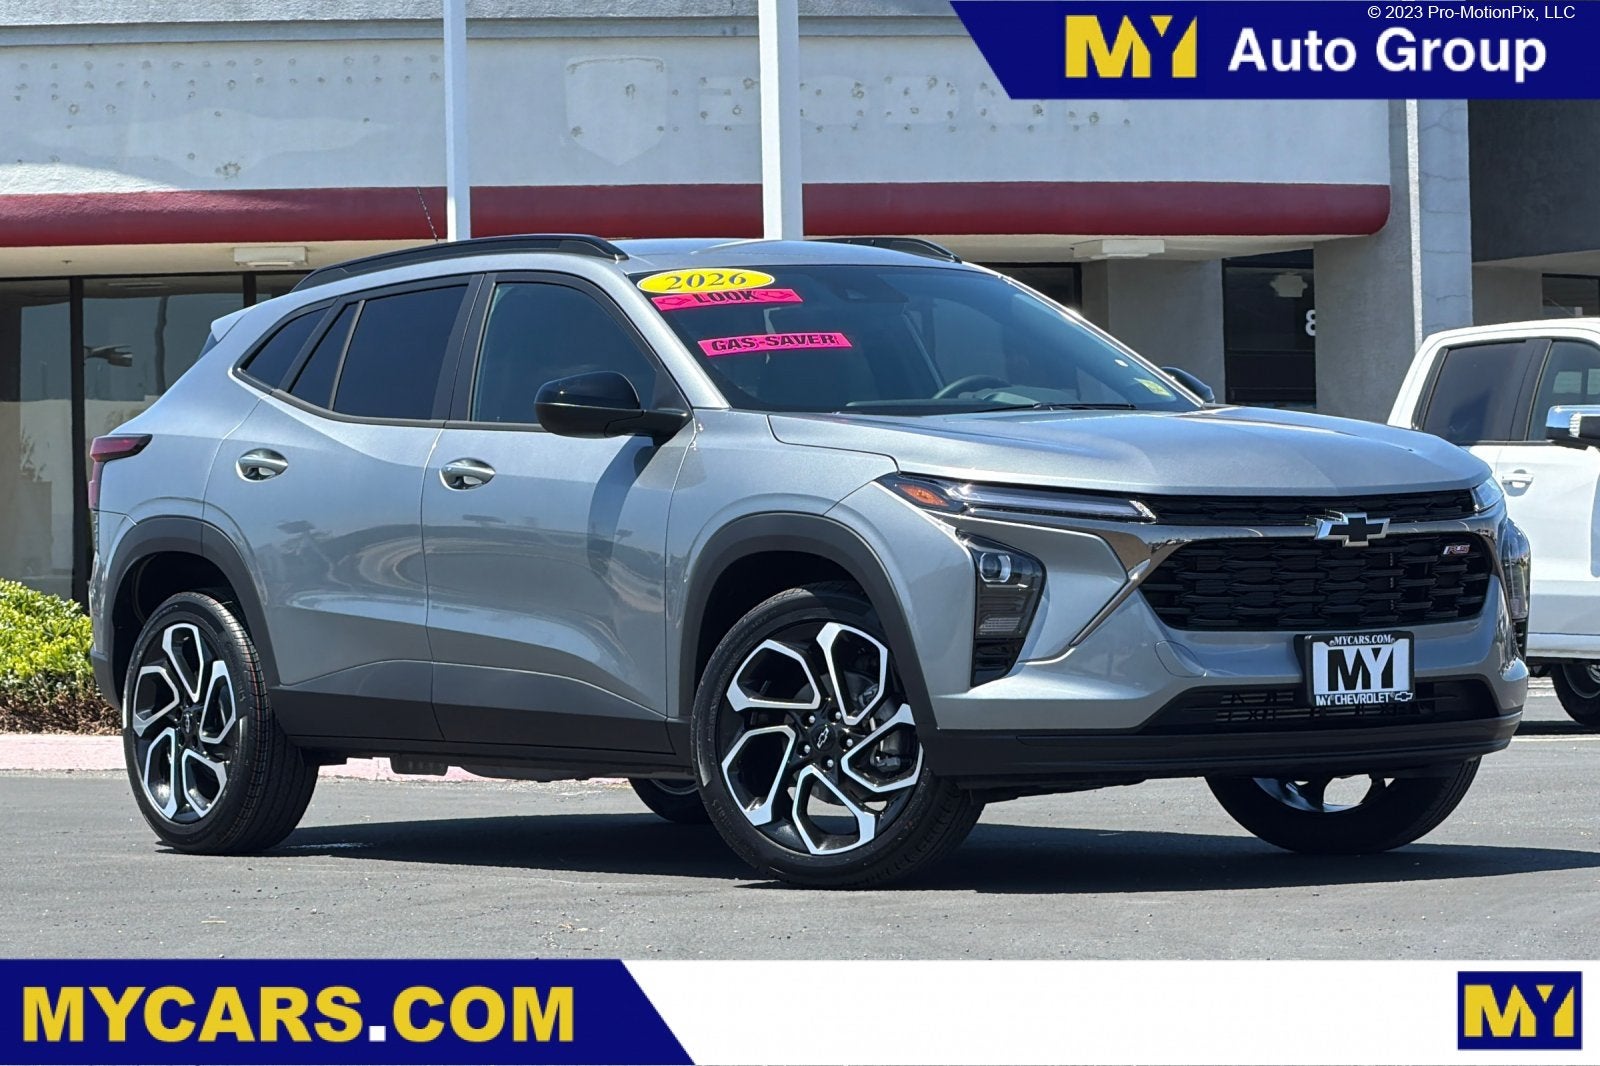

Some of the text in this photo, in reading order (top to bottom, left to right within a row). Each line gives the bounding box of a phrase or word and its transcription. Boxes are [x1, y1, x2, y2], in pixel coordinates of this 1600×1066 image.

[665, 271, 747, 291] 2026
[692, 289, 760, 304] LOOK
[711, 334, 837, 352] GAS-SAVER
[1443, 544, 1471, 555] RS
[1333, 634, 1392, 646] MYCARS.COM
[1327, 647, 1394, 692] MY
[1334, 692, 1390, 705] CHEVROLET
